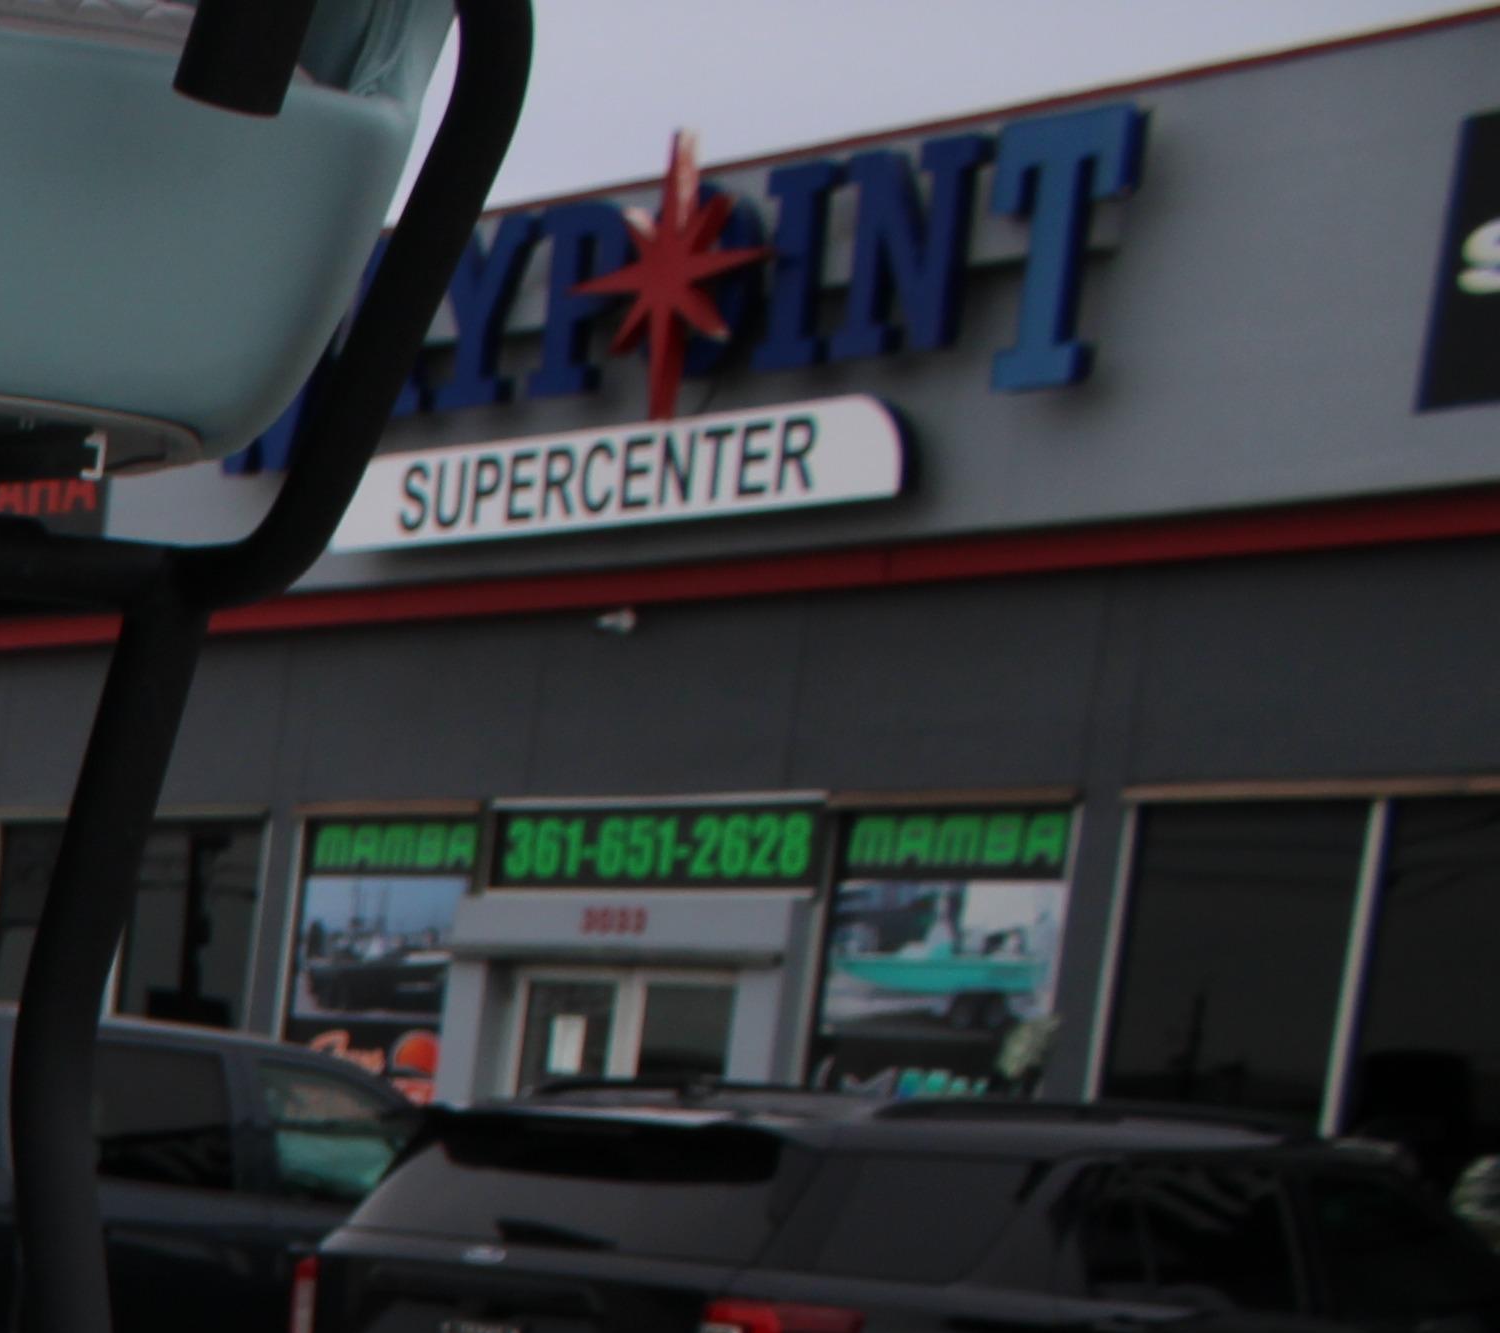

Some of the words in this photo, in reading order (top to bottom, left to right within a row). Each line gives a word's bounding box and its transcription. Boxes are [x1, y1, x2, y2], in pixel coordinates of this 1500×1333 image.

[225, 102, 1148, 474] YPOINT
[397, 413, 820, 534] SUPERCENTER
[312, 822, 477, 870] MAMBA
[503, 811, 814, 879] 361-651-2628
[846, 812, 1067, 868] MAMBA
